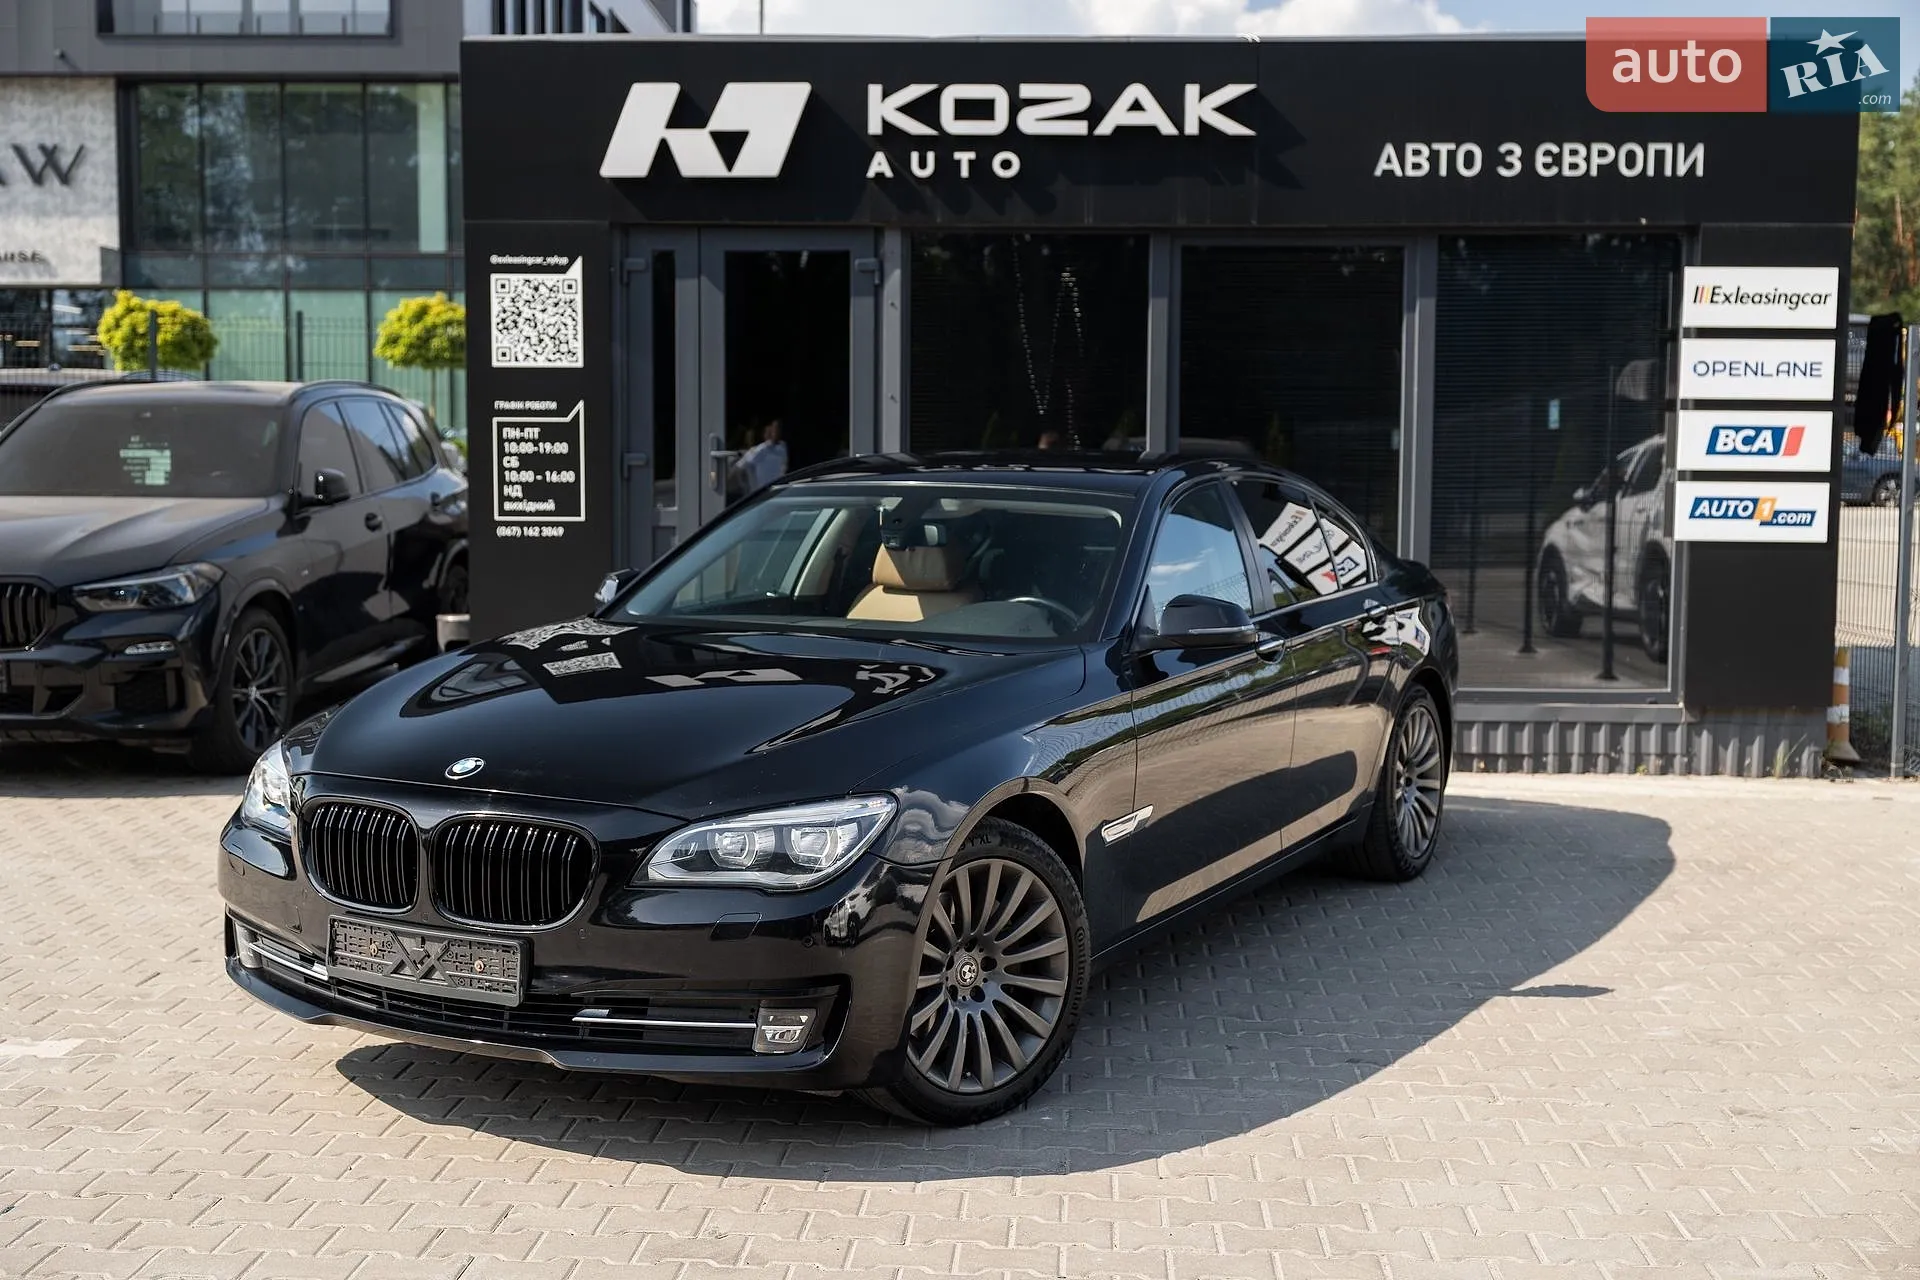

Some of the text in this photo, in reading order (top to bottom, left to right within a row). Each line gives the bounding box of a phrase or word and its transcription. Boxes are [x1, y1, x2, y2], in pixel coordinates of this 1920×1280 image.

[867, 83, 1258, 136] KOZAK
[0, 143, 85, 186] W
[866, 151, 1021, 179] AUTO
[1373, 142, 1706, 178] АВТО З ЄВРОПИ
[1710, 285, 1832, 311] Exleasingcar
[1693, 360, 1823, 378] OPENLANE
[502, 427, 541, 440] ПН-ПТ
[1715, 429, 1774, 454] BCA
[502, 456, 520, 468] СБ
[504, 470, 535, 483] 10:00
[503, 484, 523, 498] НД
